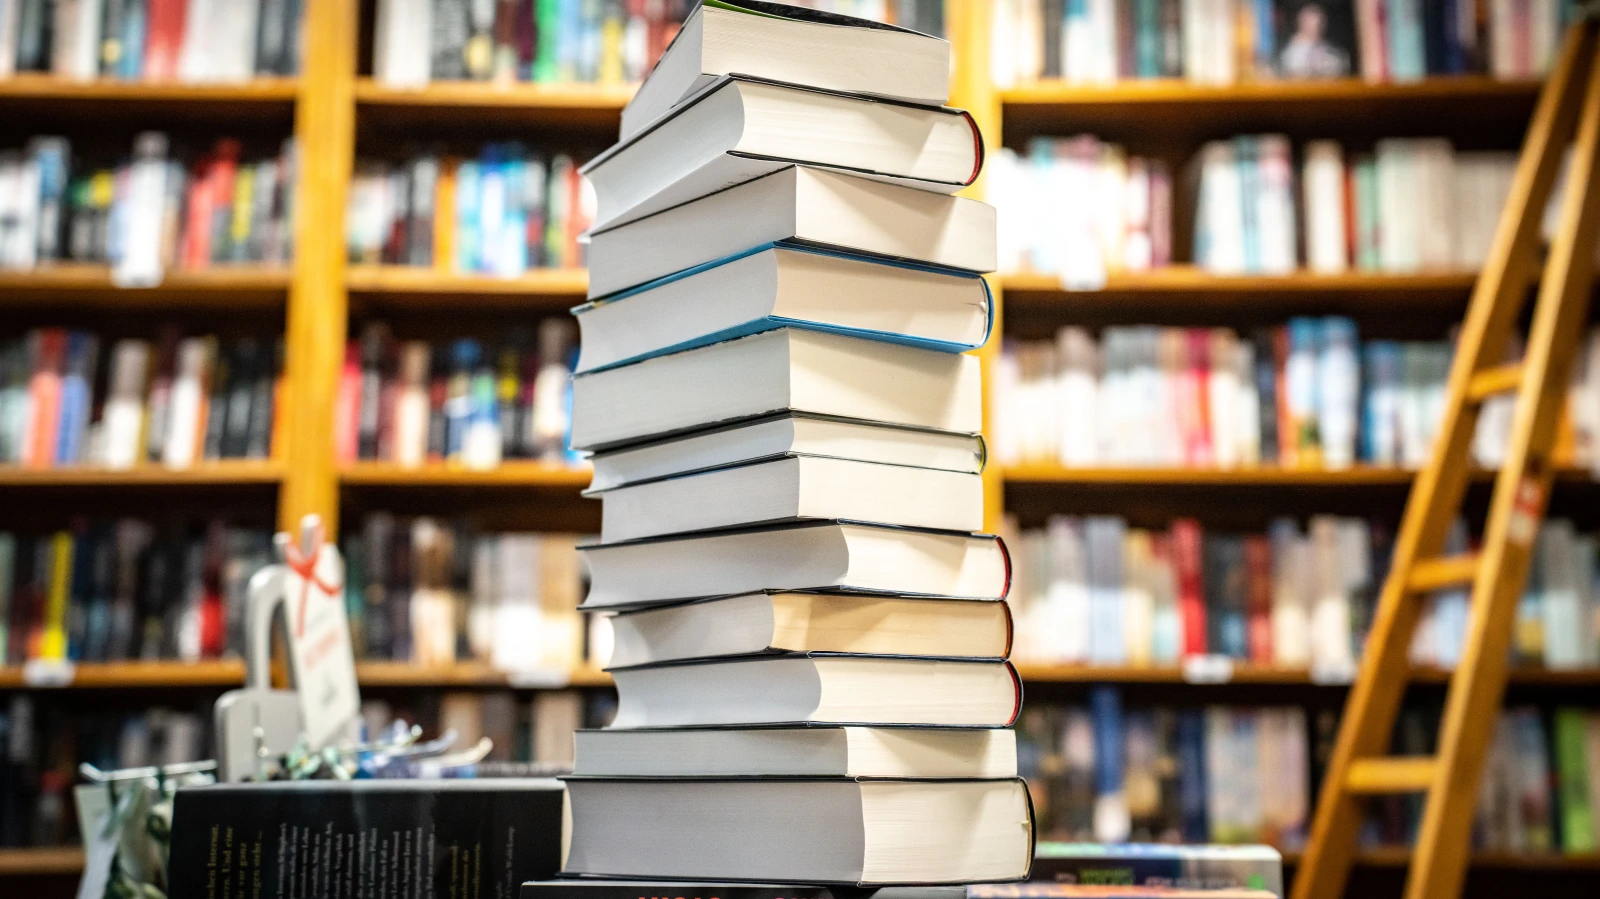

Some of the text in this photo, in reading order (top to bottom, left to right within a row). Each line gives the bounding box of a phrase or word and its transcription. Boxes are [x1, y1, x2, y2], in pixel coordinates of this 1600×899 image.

[207, 824, 219, 866] Internat.
[225, 827, 233, 847] eine
[301, 828, 309, 848] Leben
[240, 842, 248, 866] ganz
[252, 843, 262, 866] steht
